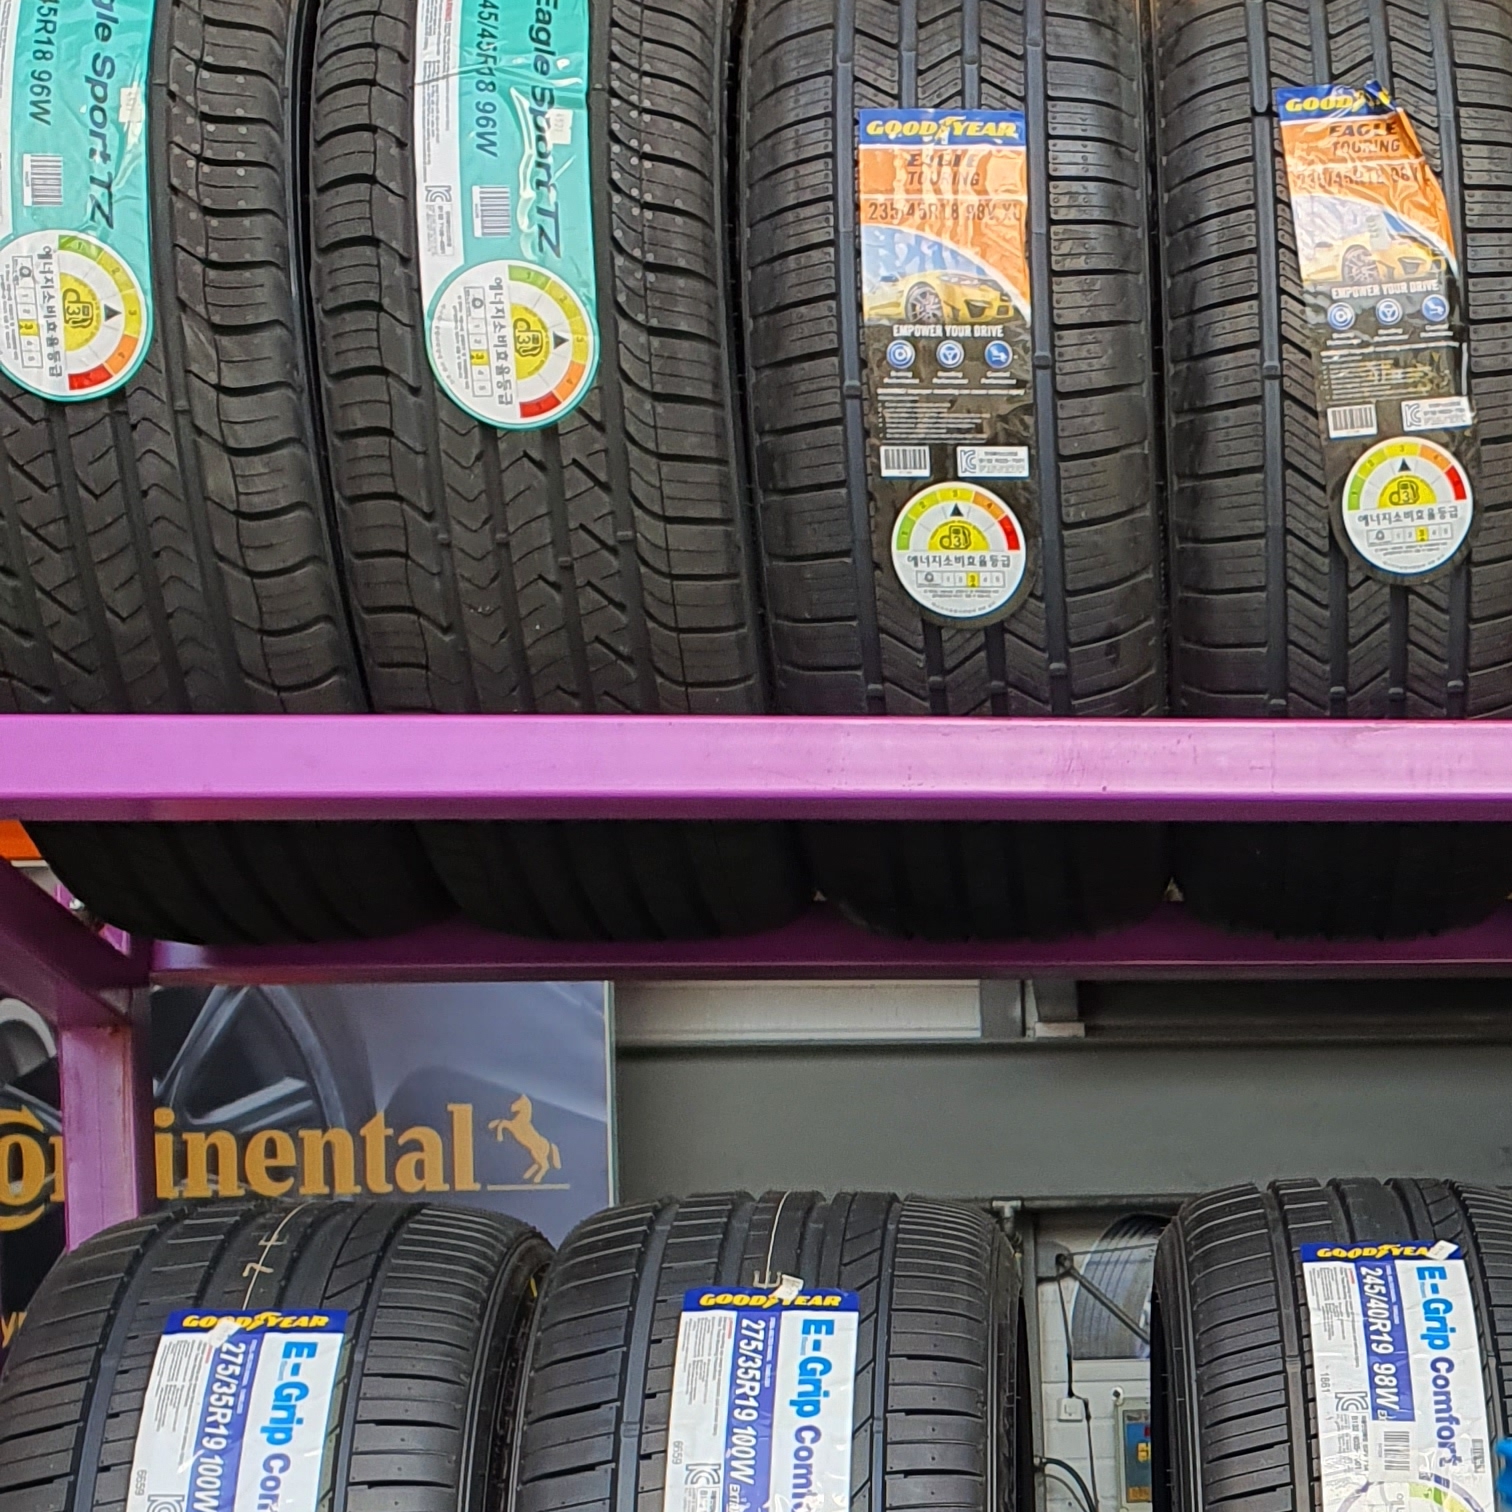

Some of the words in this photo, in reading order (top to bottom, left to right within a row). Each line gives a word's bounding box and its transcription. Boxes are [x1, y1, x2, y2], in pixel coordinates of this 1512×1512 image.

[33, 0, 60, 62] 5R18
[29, 69, 53, 126] 96W
[84, 52, 116, 165] Sport
[475, 101, 499, 158] 96W
[528, 84, 556, 194] Sport
[866, 116, 1017, 141] GOODYEAR
[89, 171, 114, 230] TZ
[536, 200, 562, 259] TZ
[1331, 284, 1380, 299] EMPOWER
[1382, 281, 1408, 296] YOUR
[1410, 279, 1440, 293] DRIVE
[892, 325, 943, 337] EMPOWER
[945, 325, 972, 337] YOUR
[974, 325, 1004, 337] DRIVE
[907, 554, 1011, 568] 에너지소비효율등급
[0, 1104, 481, 1231] oinental
[1317, 1245, 1430, 1259] GOODYEA
[699, 1293, 842, 1309] GOODEAR
[1360, 1266, 1394, 1355] 245/40R19
[1416, 1266, 1457, 1350] E-Grip
[202, 1342, 246, 1450] 275/35R19
[260, 1341, 319, 1447] E-Grip
[733, 1318, 766, 1421] 275/35R19
[789, 1319, 835, 1418] E-Grip
[1371, 1363, 1400, 1411] 98W
[1430, 1356, 1463, 1468] Comfort
[730, 1426, 757, 1485] 100W
